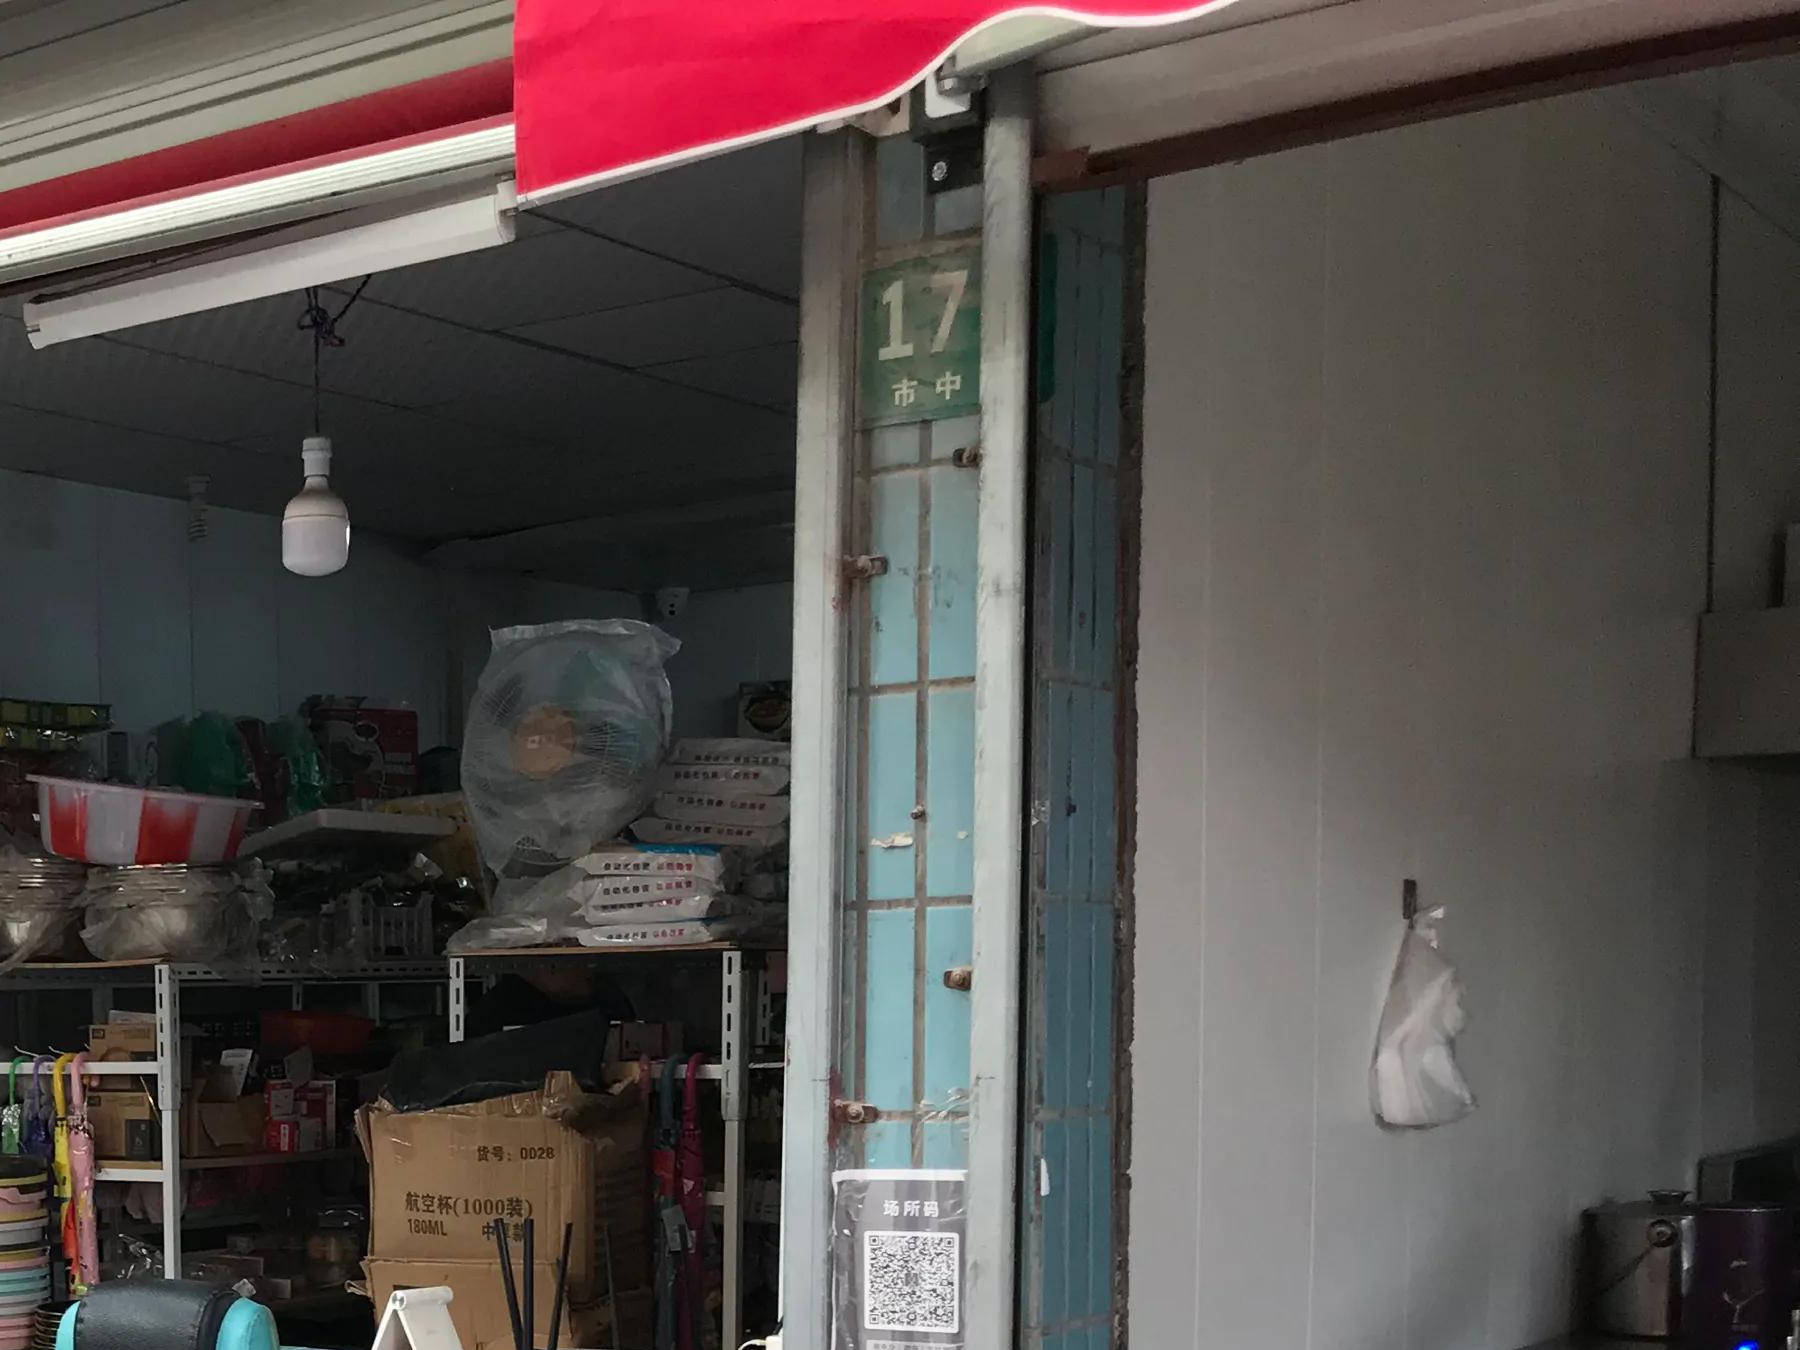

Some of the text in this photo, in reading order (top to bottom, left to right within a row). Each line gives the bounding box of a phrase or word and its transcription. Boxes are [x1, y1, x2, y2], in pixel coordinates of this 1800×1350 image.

[877, 269, 969, 361] 17
[890, 371, 962, 408] 市中
[405, 1191, 533, 1218] 航空杯(1000装)
[882, 1199, 940, 1219] 场所码
[407, 1218, 449, 1237] 180ML
